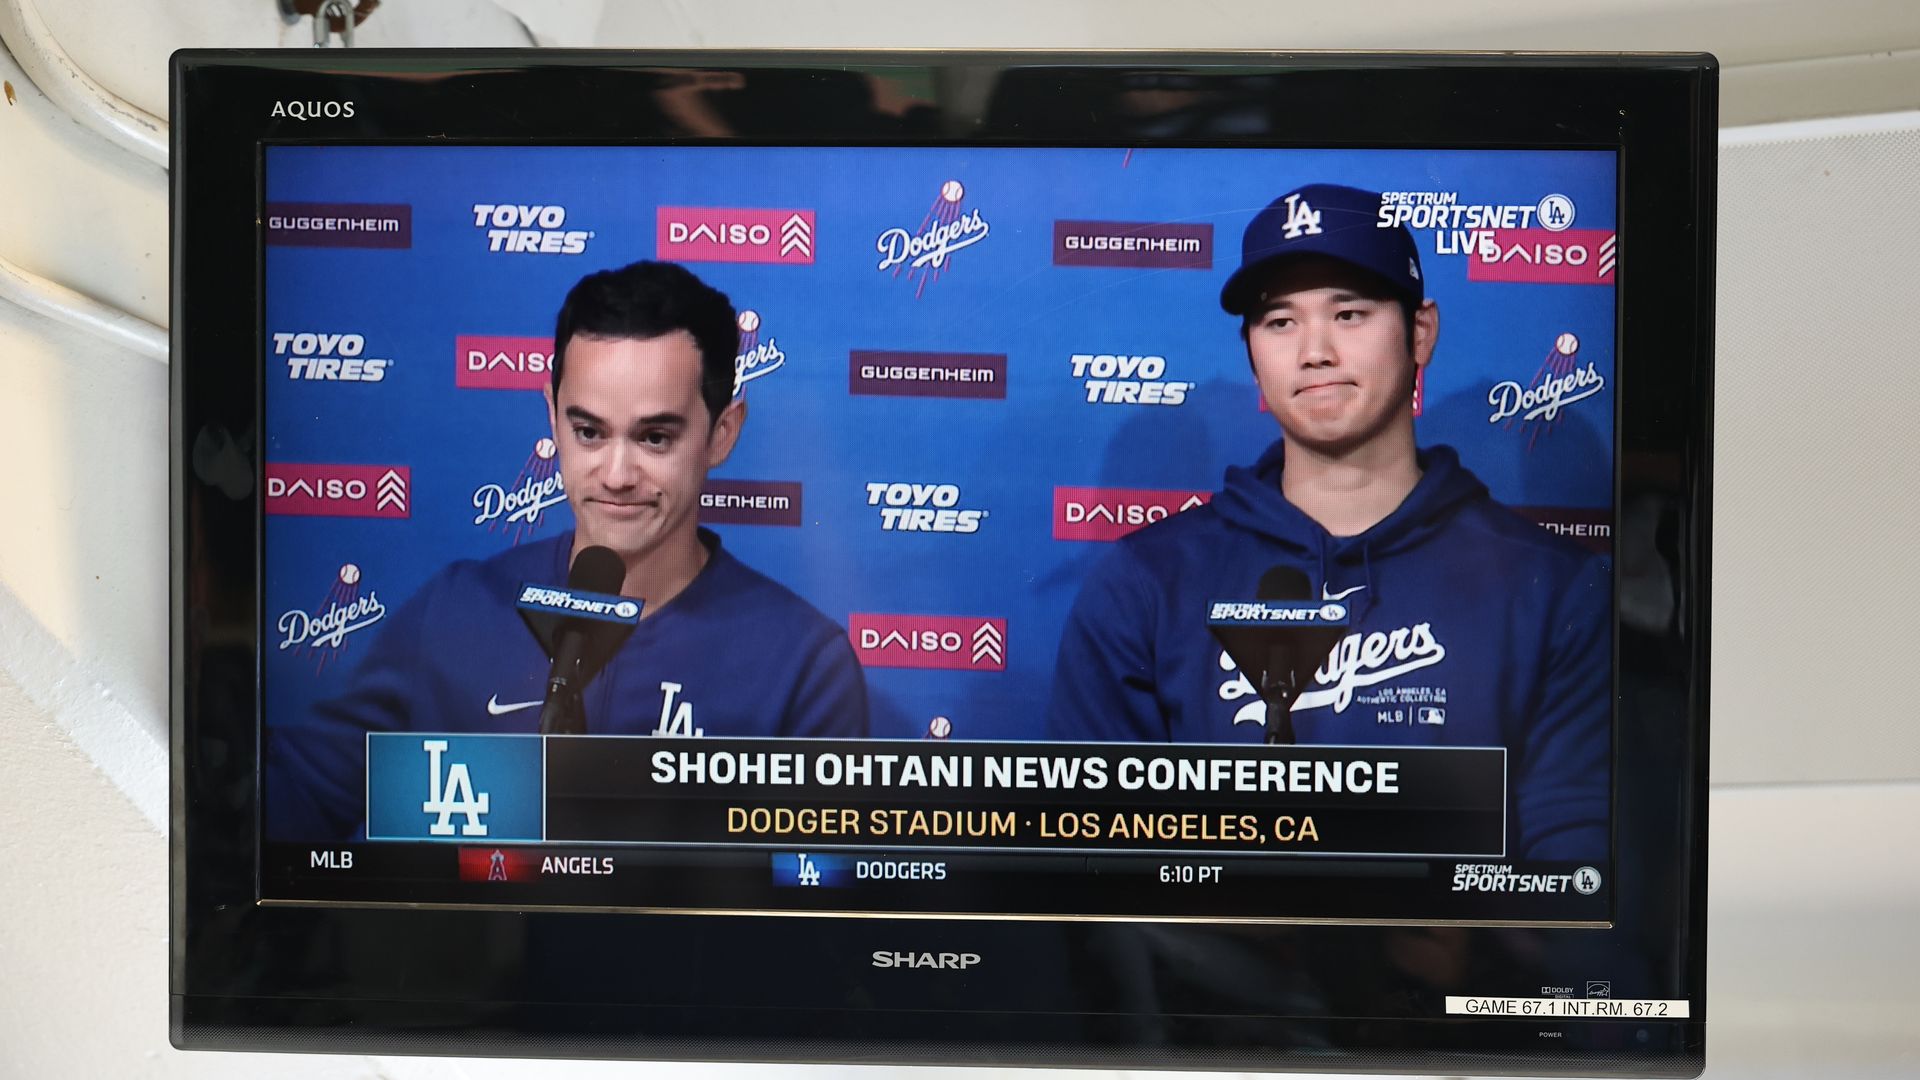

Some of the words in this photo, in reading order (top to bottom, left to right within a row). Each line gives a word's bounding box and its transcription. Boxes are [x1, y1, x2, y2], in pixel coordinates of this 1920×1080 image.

[271, 100, 355, 120] AQUOS
[1381, 192, 1457, 205] SPECTRUM
[269, 216, 399, 232] GUGGENHEIM
[473, 204, 566, 228] TOYO
[1282, 194, 1323, 239] LA
[1377, 205, 1536, 228] SPORTSNET
[488, 231, 588, 254] TIRES
[669, 223, 770, 244] DAISO
[877, 209, 990, 270] Dodgers
[1065, 236, 1200, 252] GUGGENHEIM
[1437, 231, 1495, 254] LIVE
[1482, 243, 1588, 265] DAISO
[272, 333, 365, 356] TOYO
[288, 358, 388, 381] TIRES
[468, 351, 556, 372] DAIS
[732, 338, 785, 396] gers
[1070, 355, 1166, 379] TOYO
[861, 366, 994, 382] GUGGENHEIM
[1086, 381, 1186, 404] TIRES
[1488, 362, 1604, 423] Dodgers
[267, 477, 366, 499] DAISO
[473, 471, 567, 525] Dodger
[866, 483, 959, 507] TOYO
[700, 494, 789, 510] GENHEIM
[881, 509, 981, 533] TIRES
[1066, 502, 1168, 525] DAISO
[1538, 522, 1610, 537] NHEIM
[520, 593, 616, 614] SPORTSNET
[1210, 608, 1320, 620] SPORTSNET
[278, 592, 386, 650] Dodgers
[861, 629, 962, 651] DAISO
[1377, 710, 1404, 724] MLB
[650, 750, 806, 785] SHOHEI
[814, 753, 974, 787] OHTANI
[983, 756, 1110, 791] NEWS
[1117, 757, 1399, 795] CONFERENCE
[423, 740, 490, 836] LA
[727, 806, 861, 835] DODGER
[869, 809, 1017, 837] STADIUM
[1039, 812, 1101, 838] LOS
[1108, 813, 1266, 843] ANGELES,
[1274, 815, 1320, 842] CA
[310, 851, 353, 869] MLB
[541, 856, 615, 875] ANGELS
[798, 853, 820, 886] LA
[856, 861, 947, 880] DODGERS
[1455, 864, 1512, 875] SPECTRUM
[1159, 865, 1194, 883] 6:10
[1199, 866, 1223, 884] PT
[1452, 874, 1572, 893] SPORTSNET
[872, 951, 981, 969] SHARP
[1465, 999, 1516, 1014] GAME
[1522, 1001, 1556, 1015] 67.1
[1562, 1001, 1628, 1016] INT.RM.
[1633, 1002, 1668, 1017] 67.2
